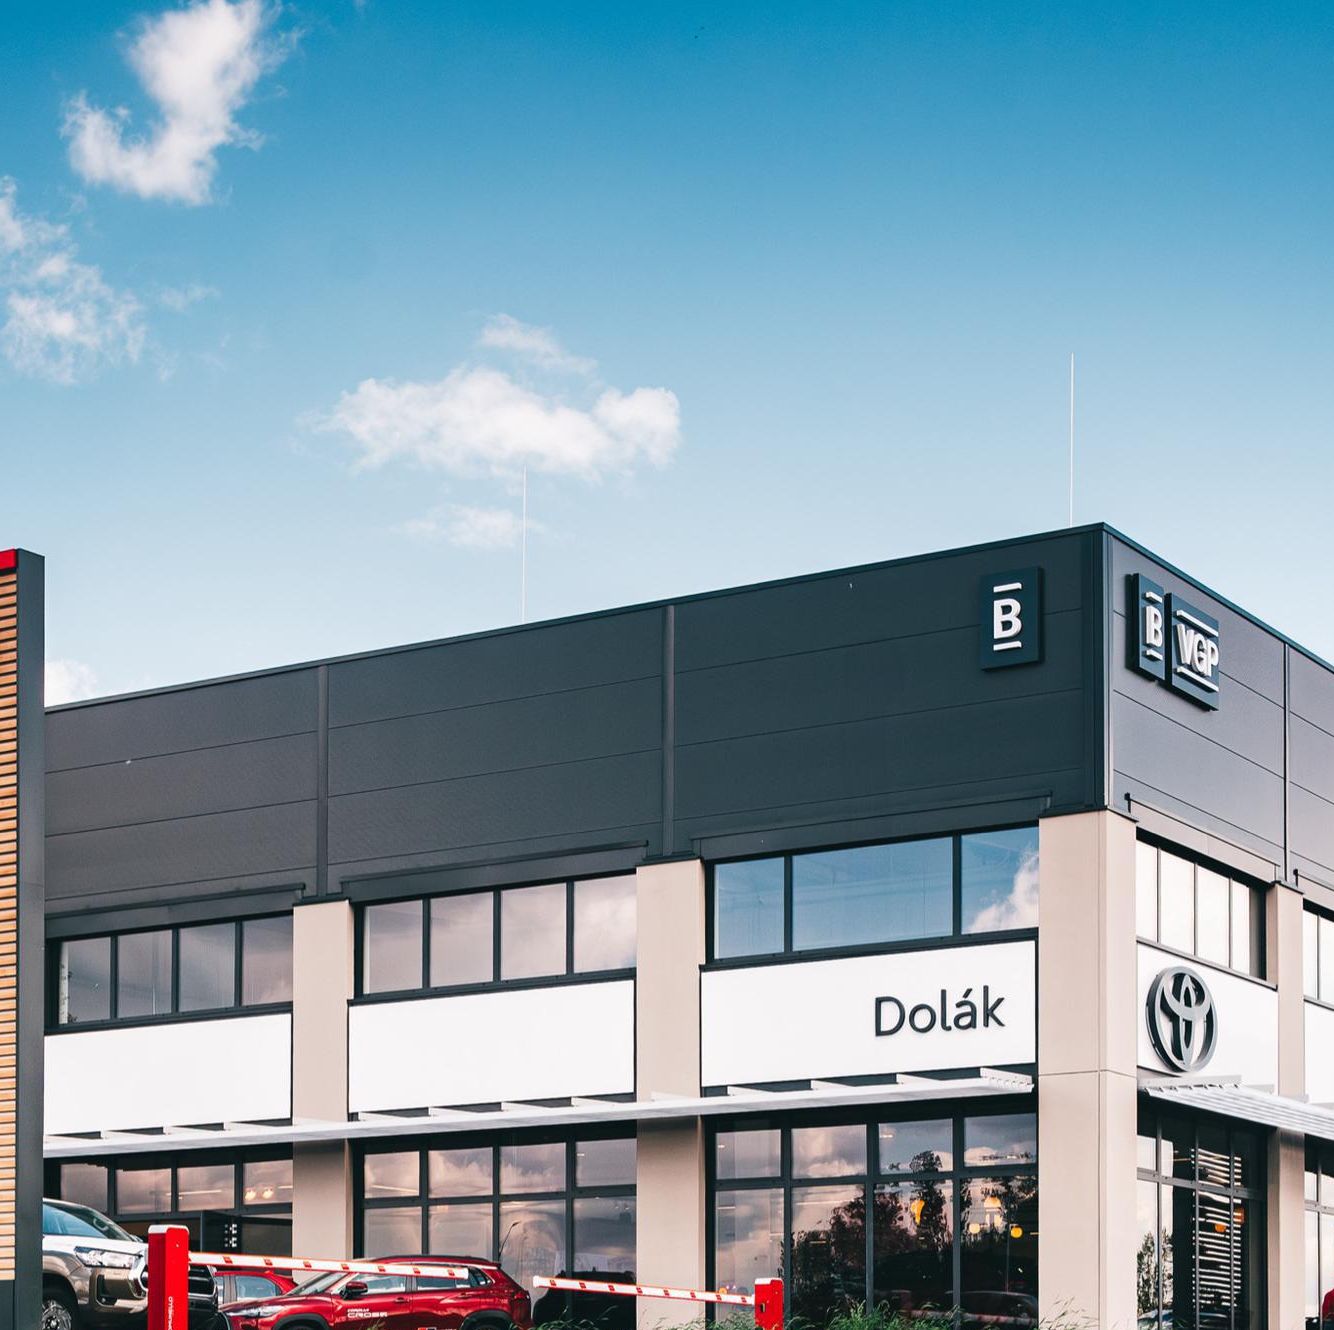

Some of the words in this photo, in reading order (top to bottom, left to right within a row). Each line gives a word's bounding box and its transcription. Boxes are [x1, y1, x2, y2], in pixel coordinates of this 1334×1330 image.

[993, 598, 1022, 640] B
[1144, 605, 1163, 648] B
[1176, 623, 1219, 677] VGP
[874, 985, 1006, 1037] Dolák
